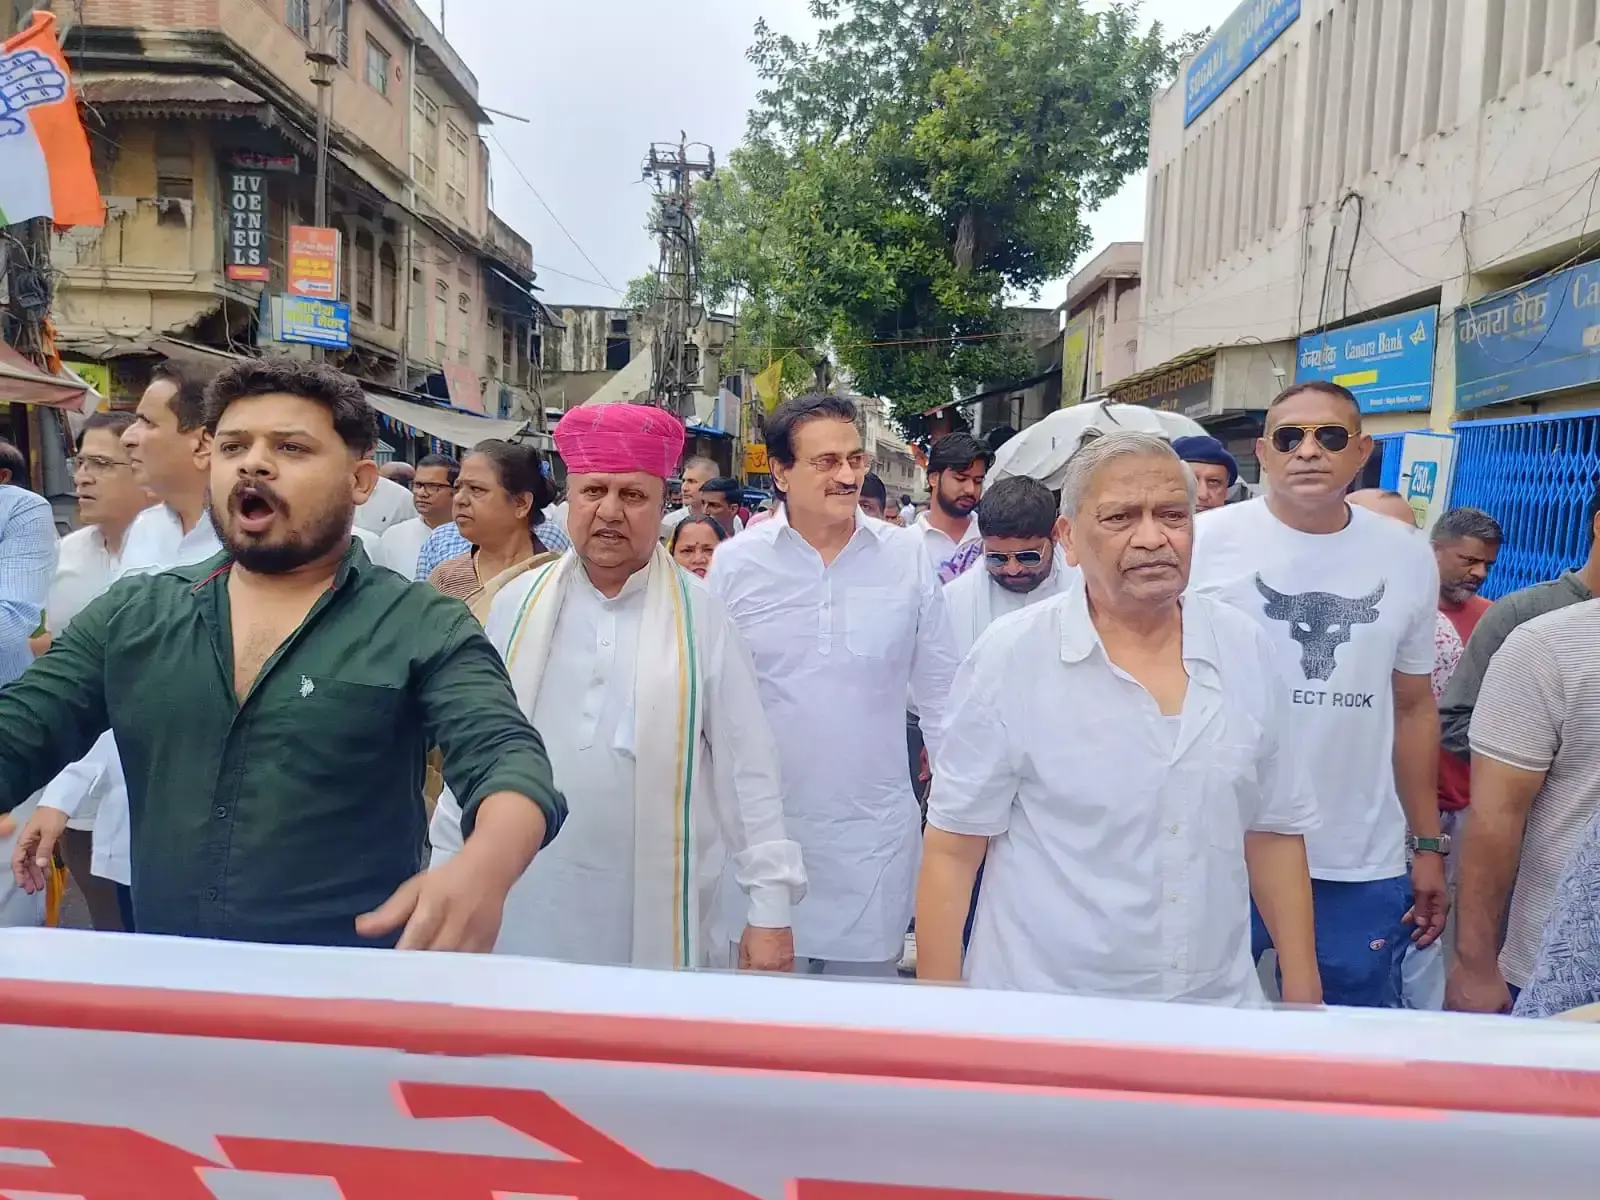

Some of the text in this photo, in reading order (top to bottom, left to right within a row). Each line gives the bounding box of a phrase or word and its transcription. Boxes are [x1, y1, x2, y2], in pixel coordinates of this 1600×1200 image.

[232, 175, 247, 266] HOTEL
[247, 175, 263, 266] VENUS
[1345, 339, 1376, 360] Canara
[1378, 328, 1403, 353] Bank
[1290, 689, 1375, 709] ECT ROCK
